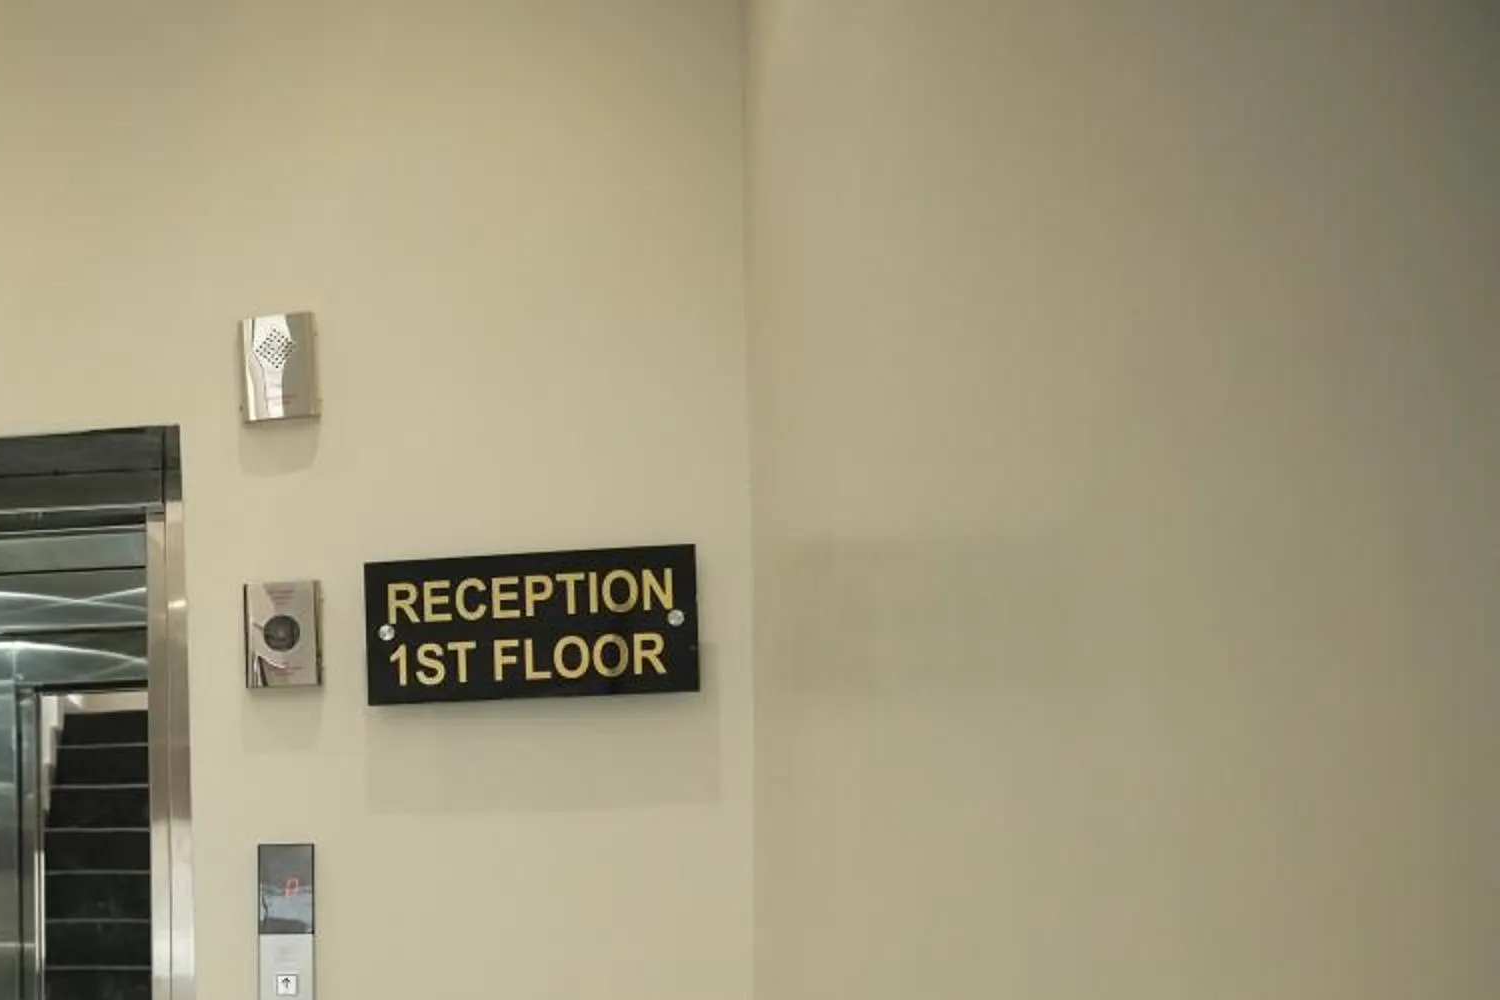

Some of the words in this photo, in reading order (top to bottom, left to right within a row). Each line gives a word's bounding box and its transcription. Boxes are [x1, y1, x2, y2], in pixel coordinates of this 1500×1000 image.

[387, 567, 674, 625] RECEPTION
[389, 640, 477, 686] 1ST
[492, 632, 667, 682] FLOOR
